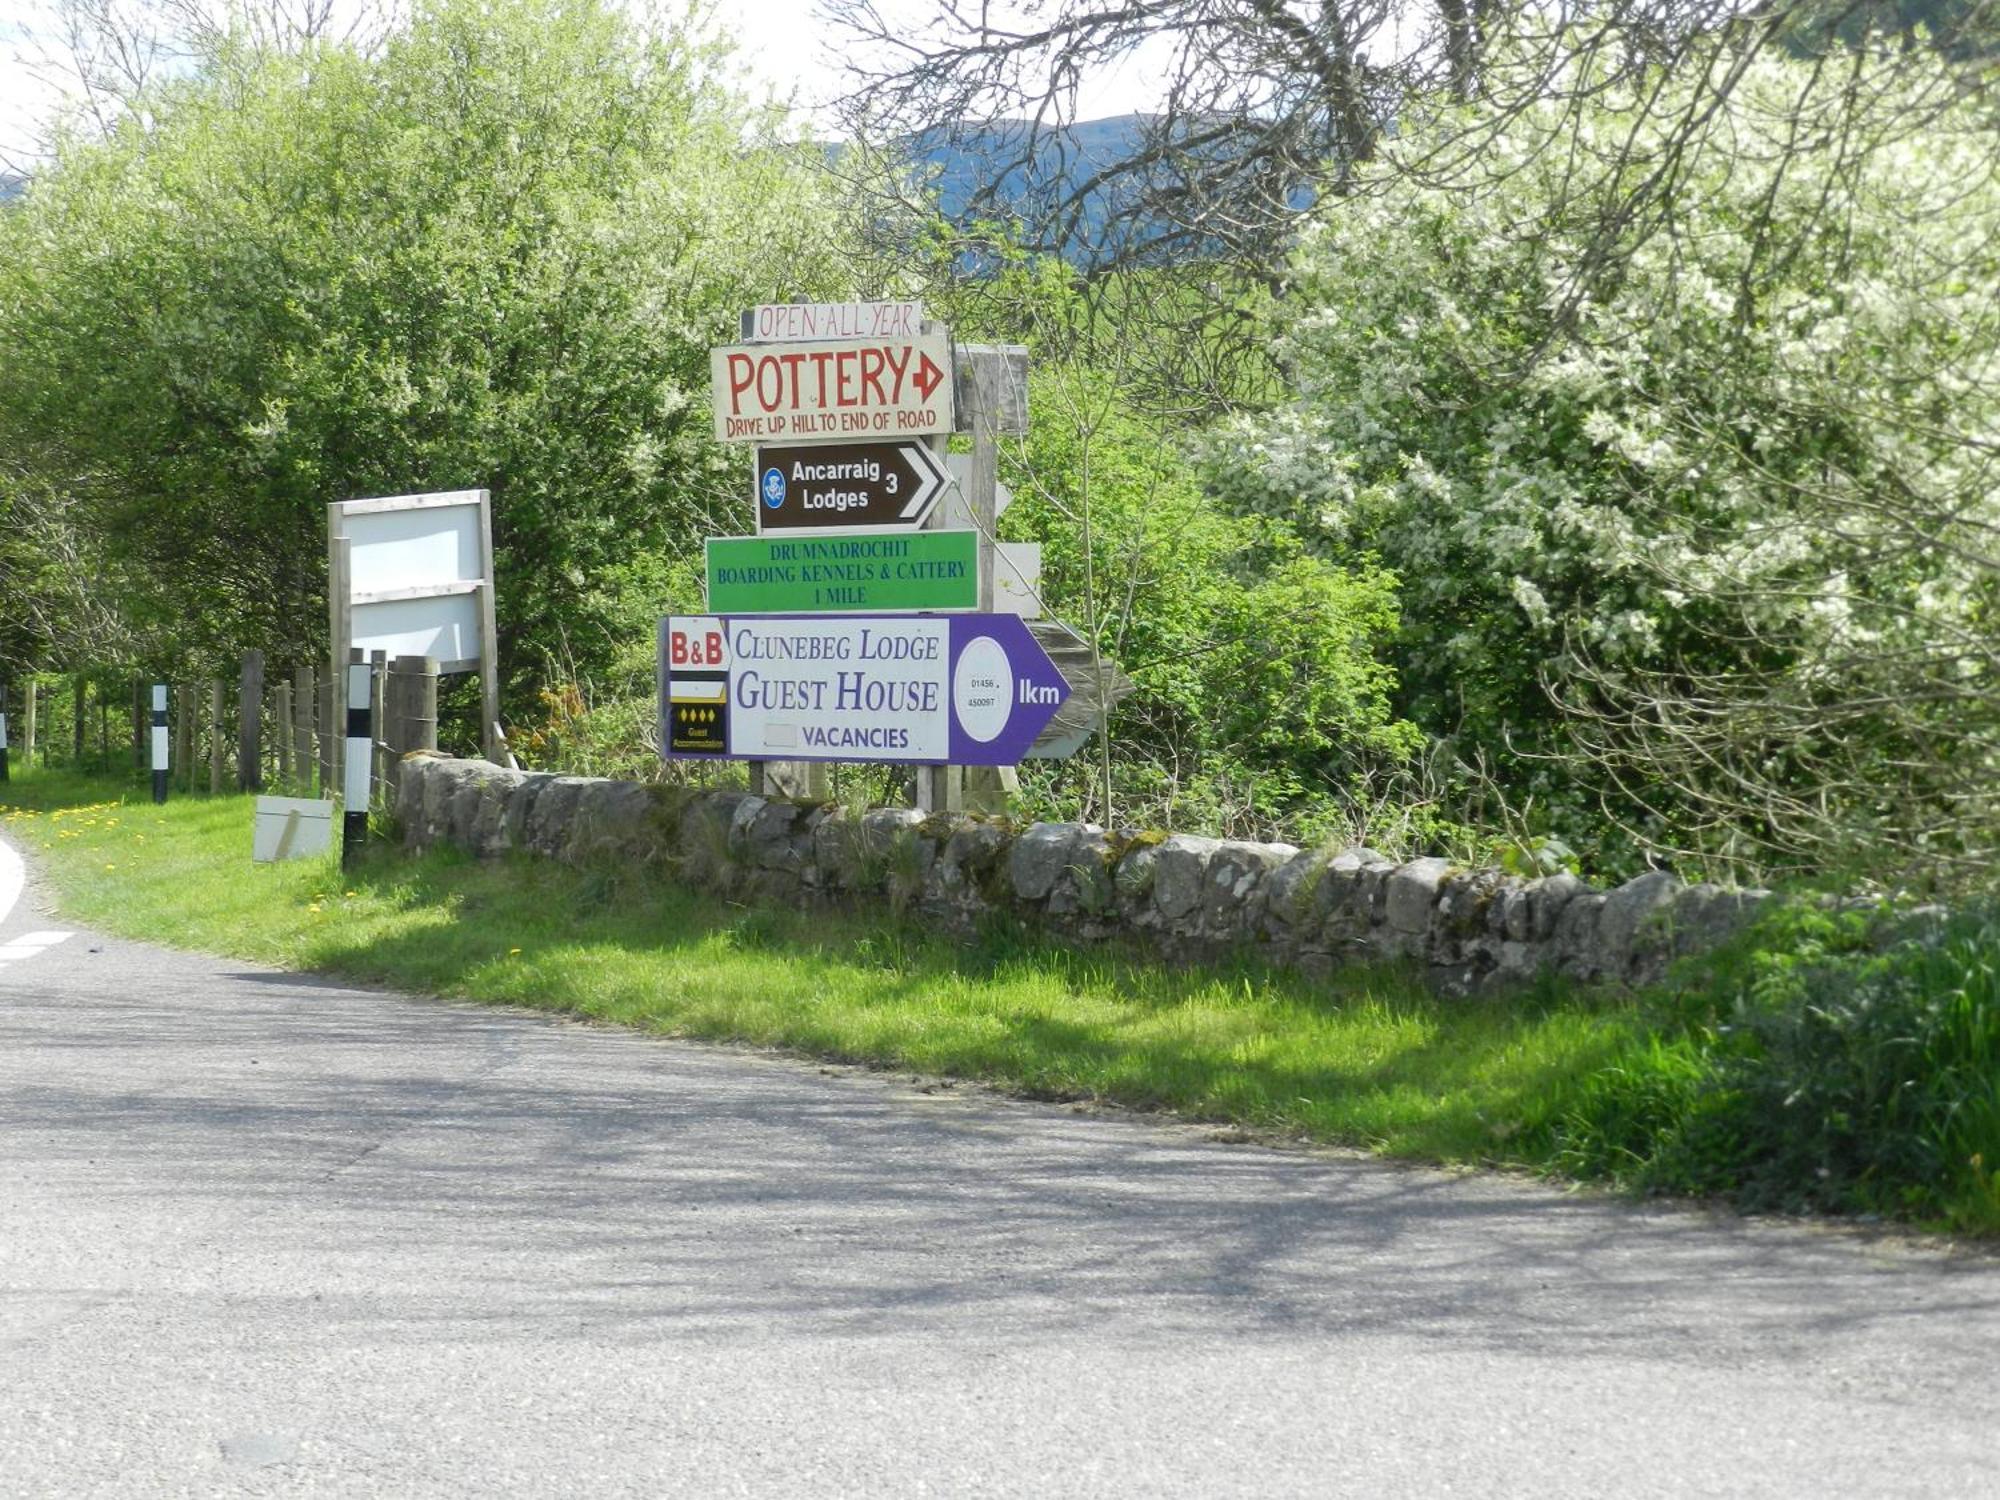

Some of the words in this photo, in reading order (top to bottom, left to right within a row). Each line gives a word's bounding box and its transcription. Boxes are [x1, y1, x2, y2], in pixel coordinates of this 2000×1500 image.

[761, 306, 816, 336] OPEN
[827, 306, 864, 336] ALL
[871, 304, 913, 335] YEAR
[727, 346, 912, 415] POTTERY
[727, 416, 763, 437] DRIVE
[768, 417, 785, 433] UP
[792, 415, 818, 433] HILL
[819, 414, 836, 431] TO
[842, 412, 868, 431] END
[873, 412, 891, 429] OF
[898, 410, 936, 428] ROAD
[792, 458, 880, 482] Ancarraig
[886, 473, 898, 494] 3
[803, 488, 869, 511] Lodges
[770, 540, 910, 560] DRUMNADROCHIT
[718, 566, 795, 584] BOARDING
[802, 563, 874, 582] KENNELS
[881, 564, 890, 579] &
[896, 561, 966, 579] CATTERY
[824, 587, 867, 604] MILE
[671, 632, 722, 664] B&B
[802, 727, 909, 748] VACANCIES
